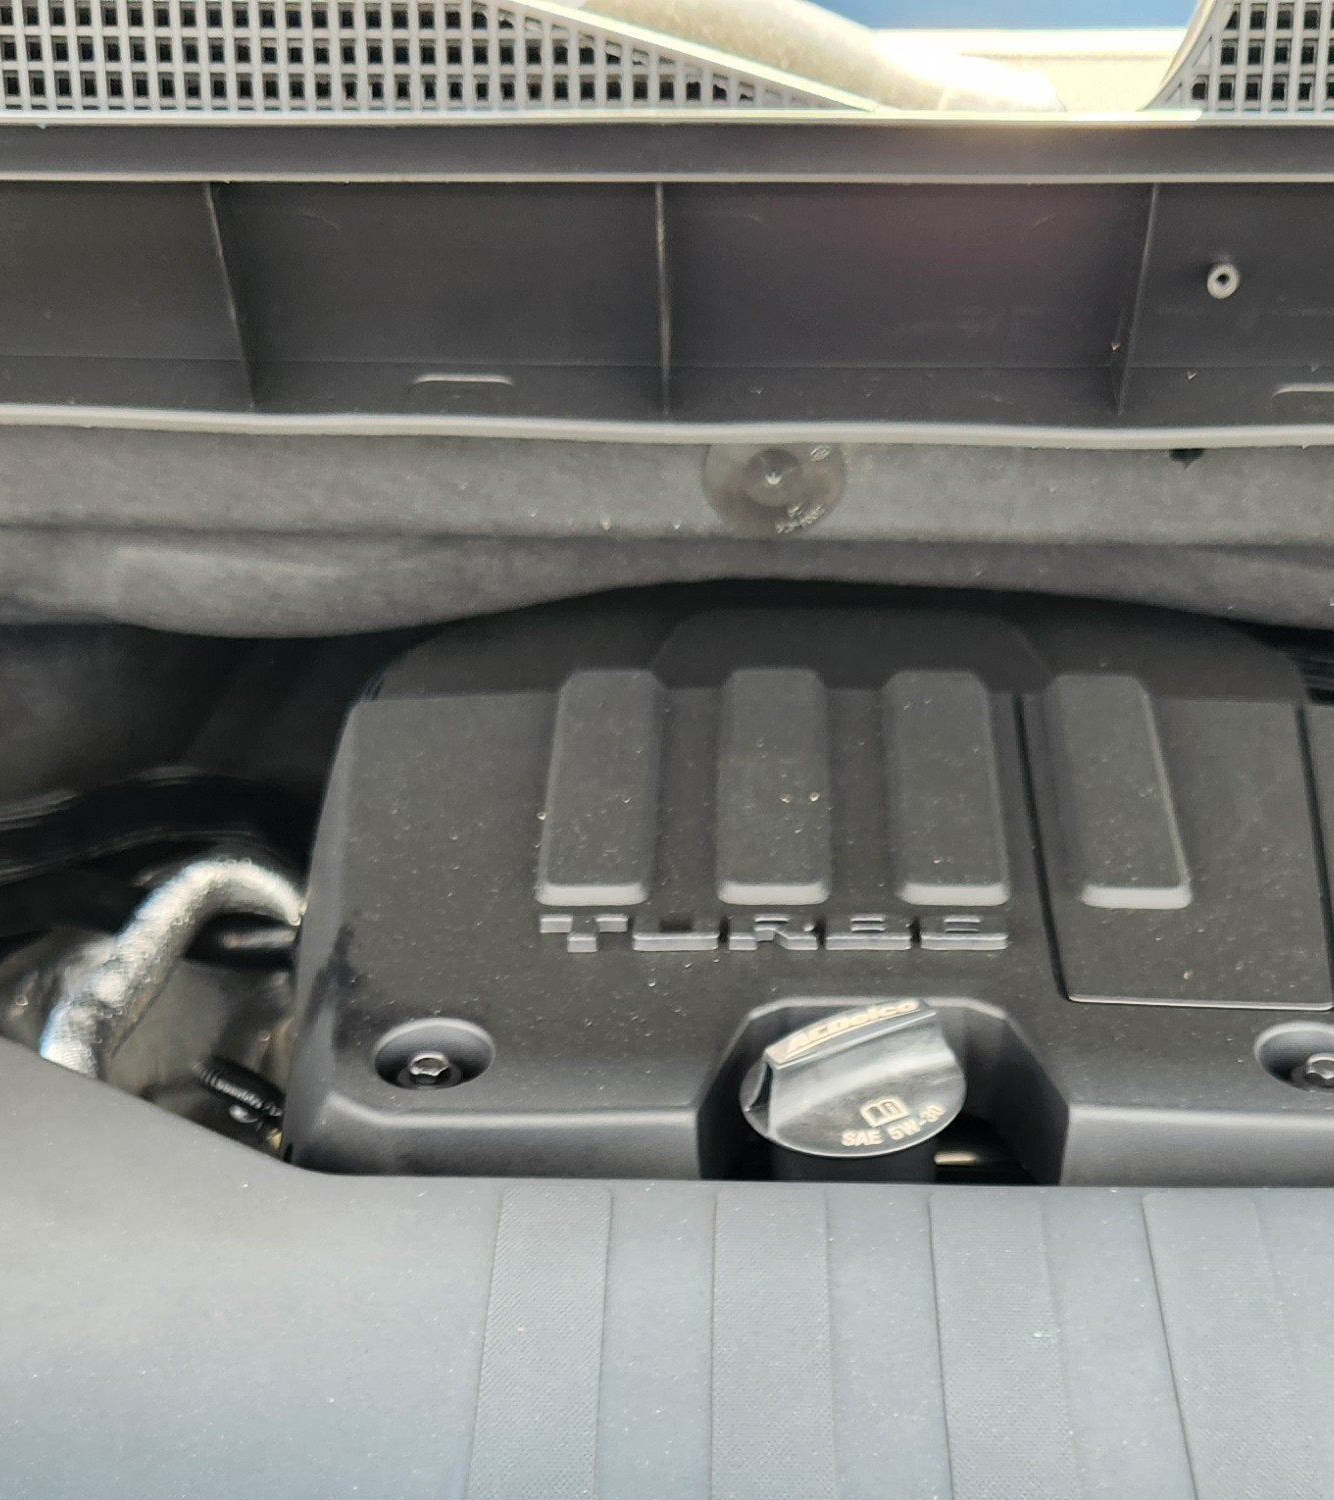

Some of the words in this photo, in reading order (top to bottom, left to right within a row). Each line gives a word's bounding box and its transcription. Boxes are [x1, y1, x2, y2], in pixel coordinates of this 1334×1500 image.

[786, 999, 920, 1056] ACDelco
[841, 1128, 883, 1147] SAE
[886, 1102, 946, 1141] 5W-30
